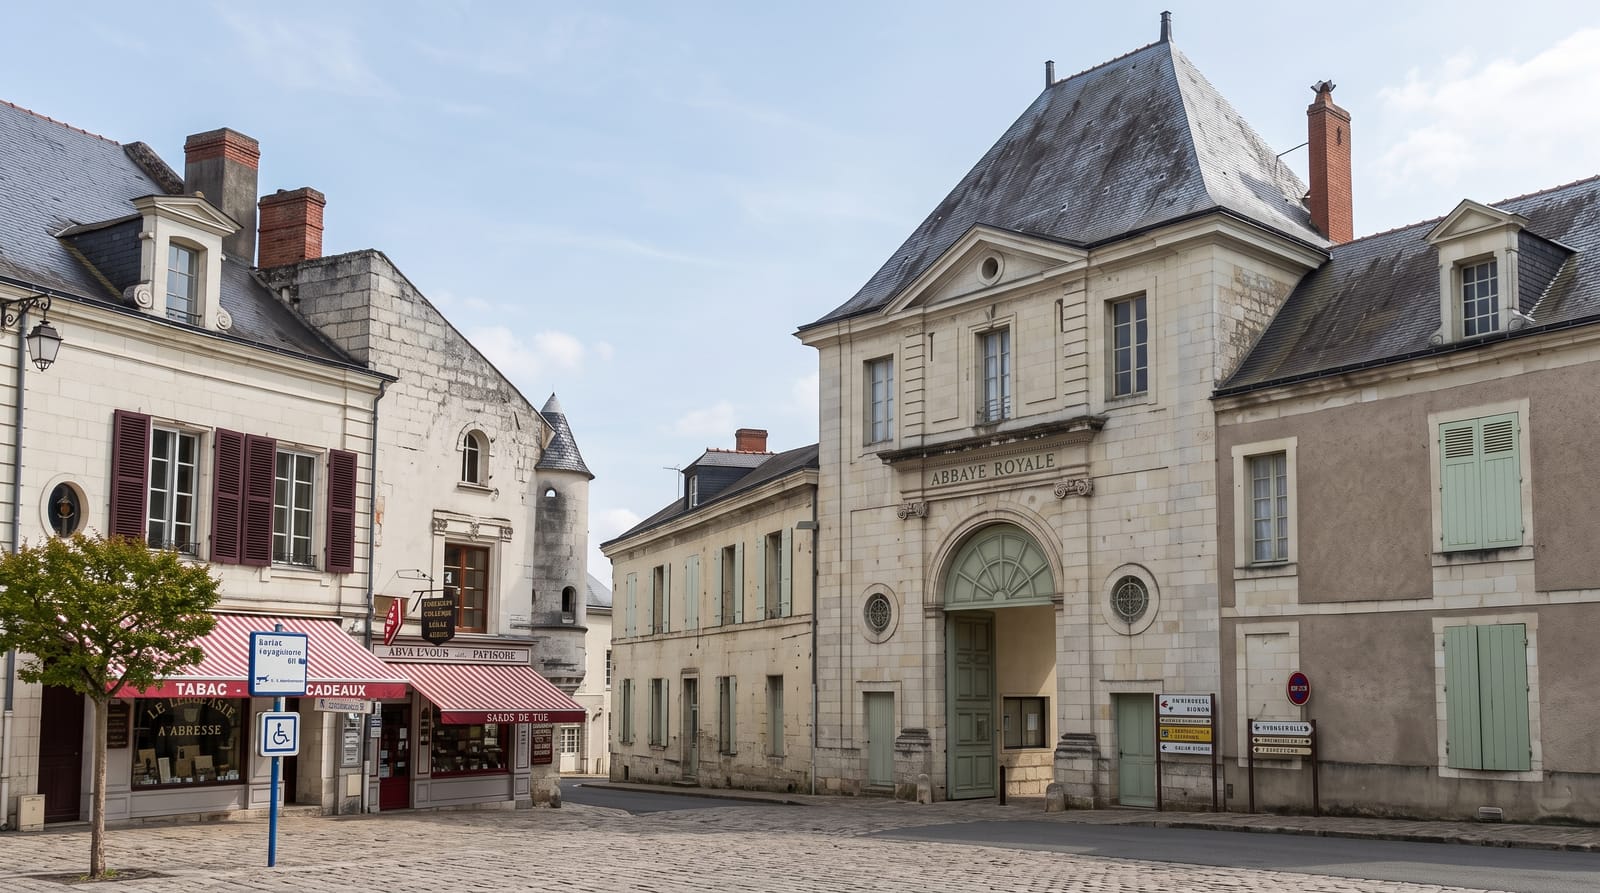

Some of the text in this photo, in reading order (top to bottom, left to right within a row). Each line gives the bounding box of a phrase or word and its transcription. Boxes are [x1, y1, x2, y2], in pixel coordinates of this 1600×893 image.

[931, 453, 1055, 486] ABBAYE ROYALE
[176, 683, 227, 696] TABAC
[306, 684, 366, 696] CADEAUX
[147, 702, 166, 720] LE
[518, 713, 530, 722] DE
[170, 725, 222, 736] ABRESSE
